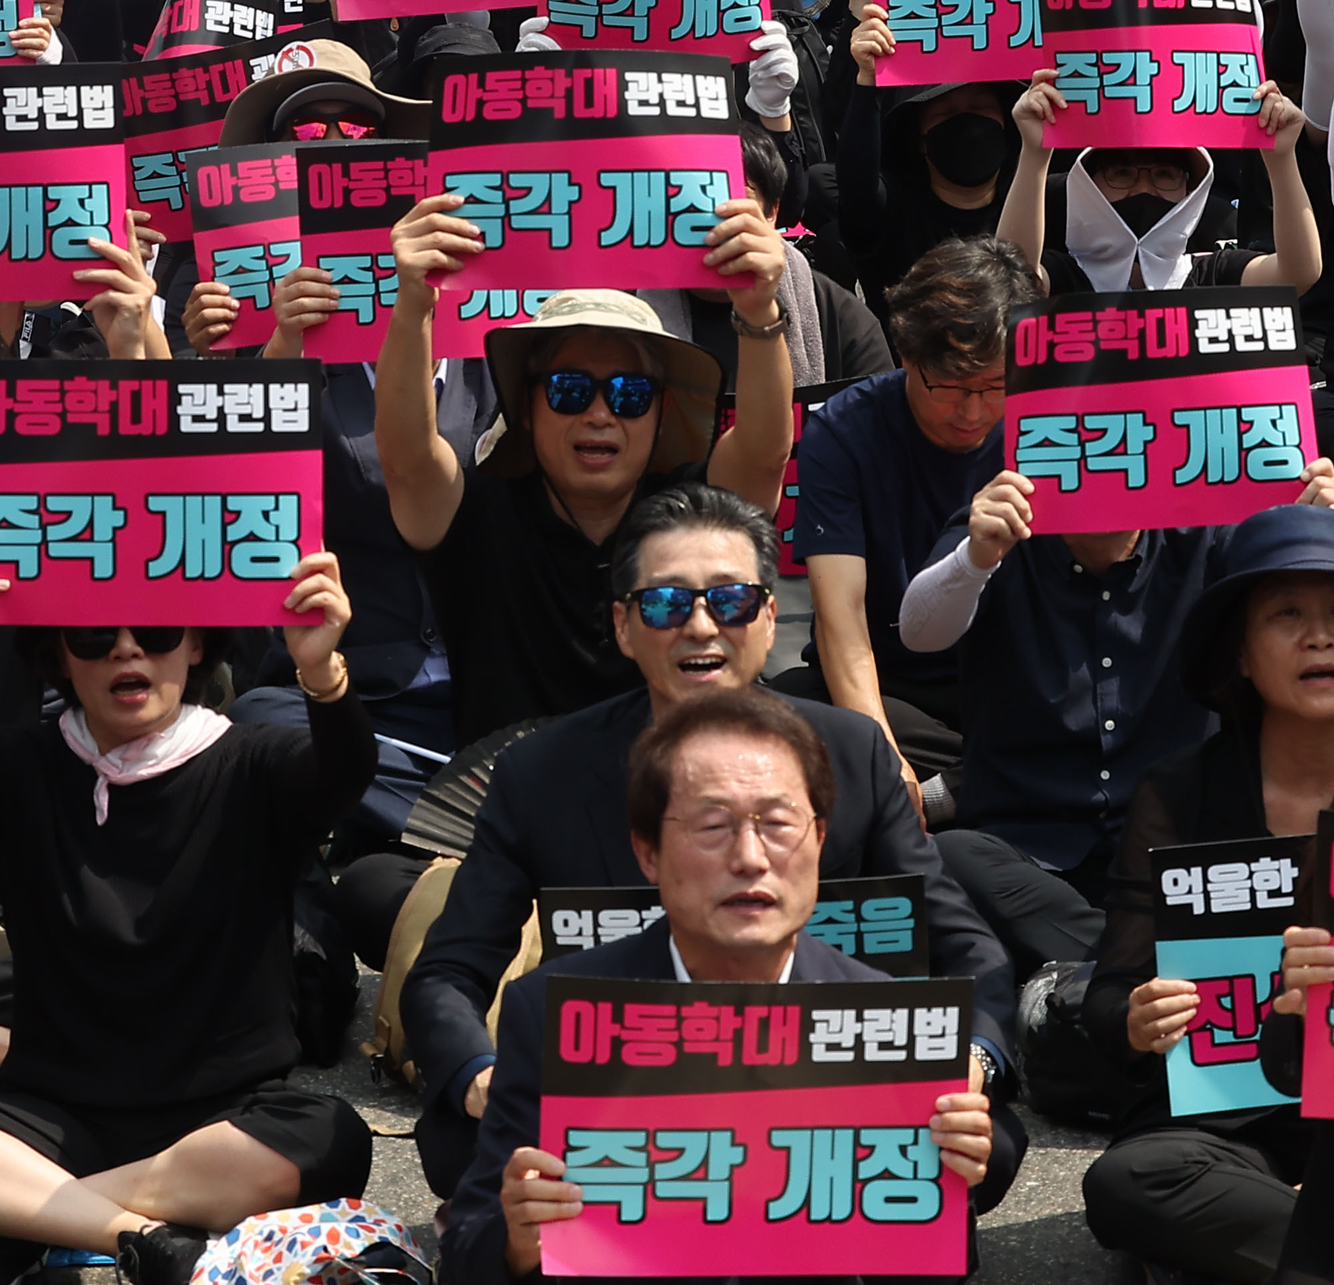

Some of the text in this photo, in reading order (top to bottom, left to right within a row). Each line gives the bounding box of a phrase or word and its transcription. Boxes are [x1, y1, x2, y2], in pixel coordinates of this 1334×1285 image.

[3, 85, 114, 130] 관련법
[442, 66, 729, 123] 아동학대 관련법
[1056, 52, 1261, 113] 즉각 개정
[446, 171, 729, 247] 즉각 개정
[1015, 307, 1296, 366] 아동학대 관련법
[177, 384, 309, 432] 관련법
[1016, 405, 1304, 490] 즉각 개정
[148, 495, 299, 578] 개정
[1159, 857, 1299, 915] 억울한
[806, 896, 916, 955] 죽음
[560, 1000, 959, 1066] 아동학대 관련법
[1189, 974, 1267, 1068] 진
[563, 1129, 939, 1221] 즉각 개정
